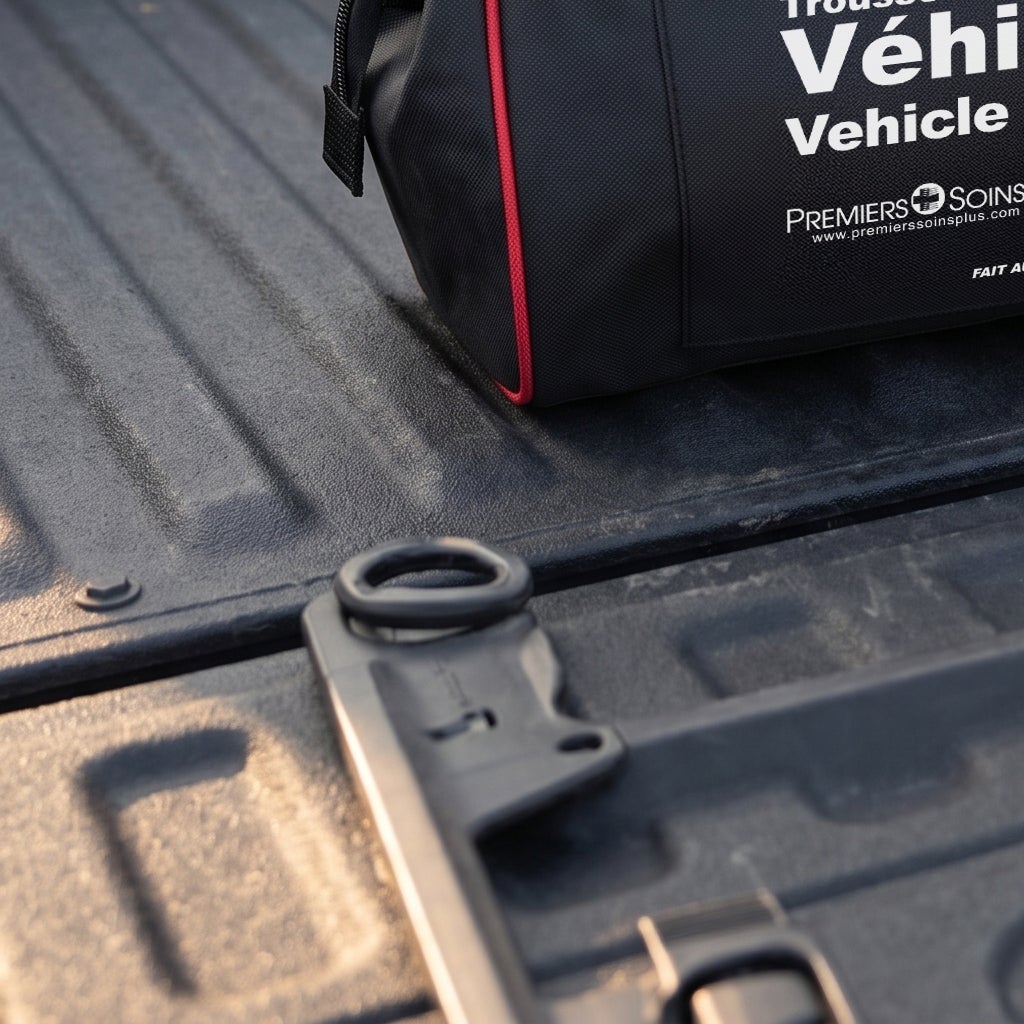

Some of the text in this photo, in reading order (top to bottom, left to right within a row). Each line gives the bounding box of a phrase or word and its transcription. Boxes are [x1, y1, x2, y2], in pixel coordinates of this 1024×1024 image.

[784, 95, 1009, 156] Vehicle
[786, 198, 909, 234] PREMIERS
[811, 207, 1020, 243] www.premierssoinsplus.com
[972, 264, 1008, 279] FAIT
